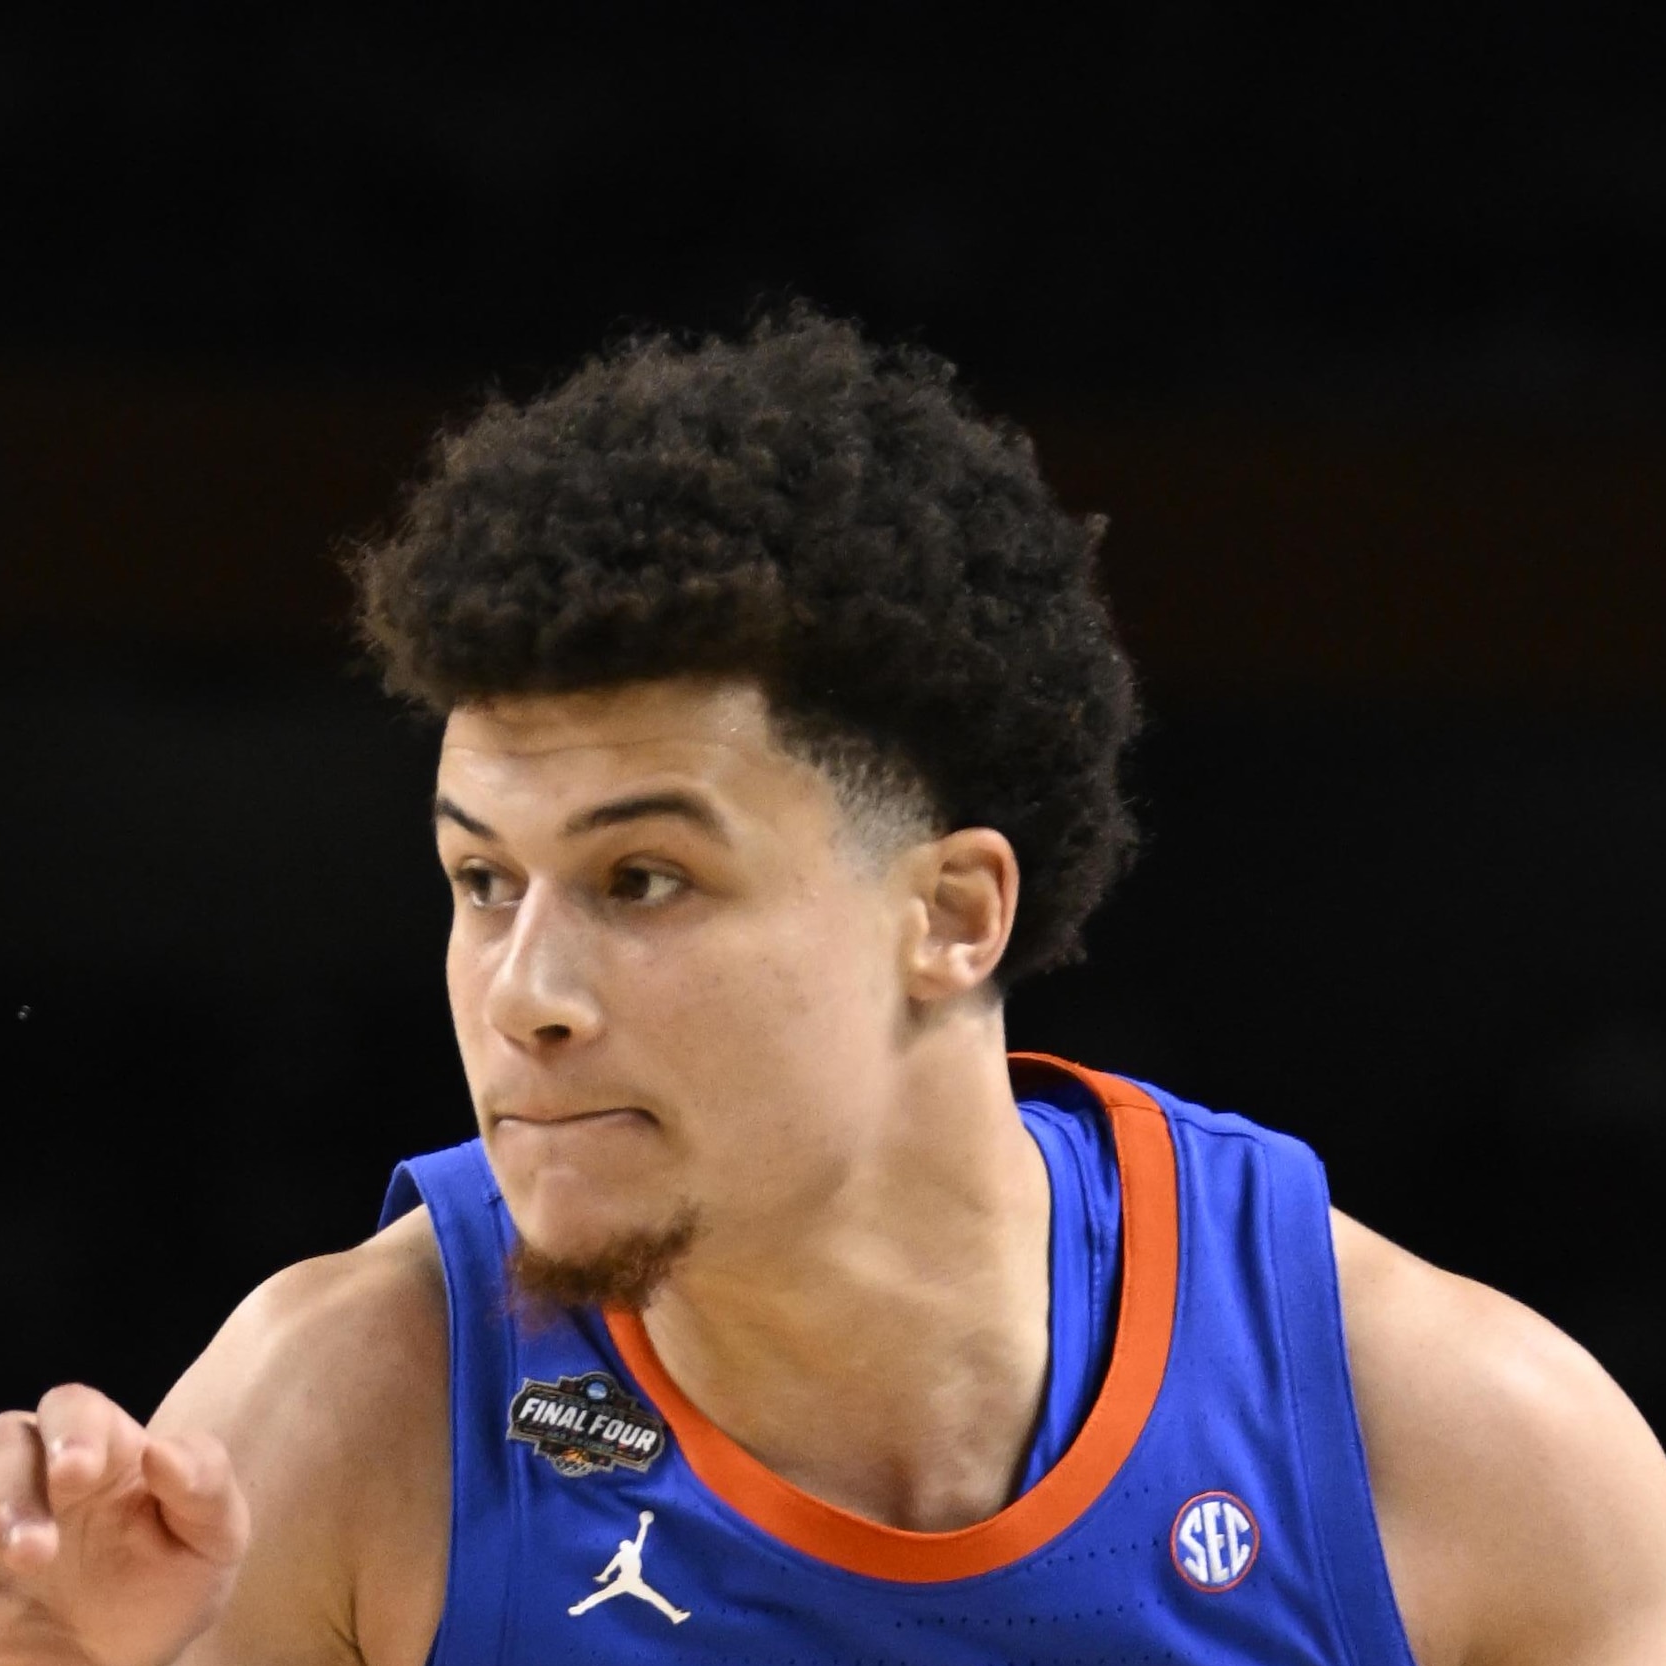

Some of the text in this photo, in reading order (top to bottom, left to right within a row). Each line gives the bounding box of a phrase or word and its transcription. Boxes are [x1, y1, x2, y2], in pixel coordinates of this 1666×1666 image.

[518, 1397, 586, 1433] FINAL
[588, 1414, 658, 1453] FOUR
[1173, 1495, 1252, 1586] SEC
